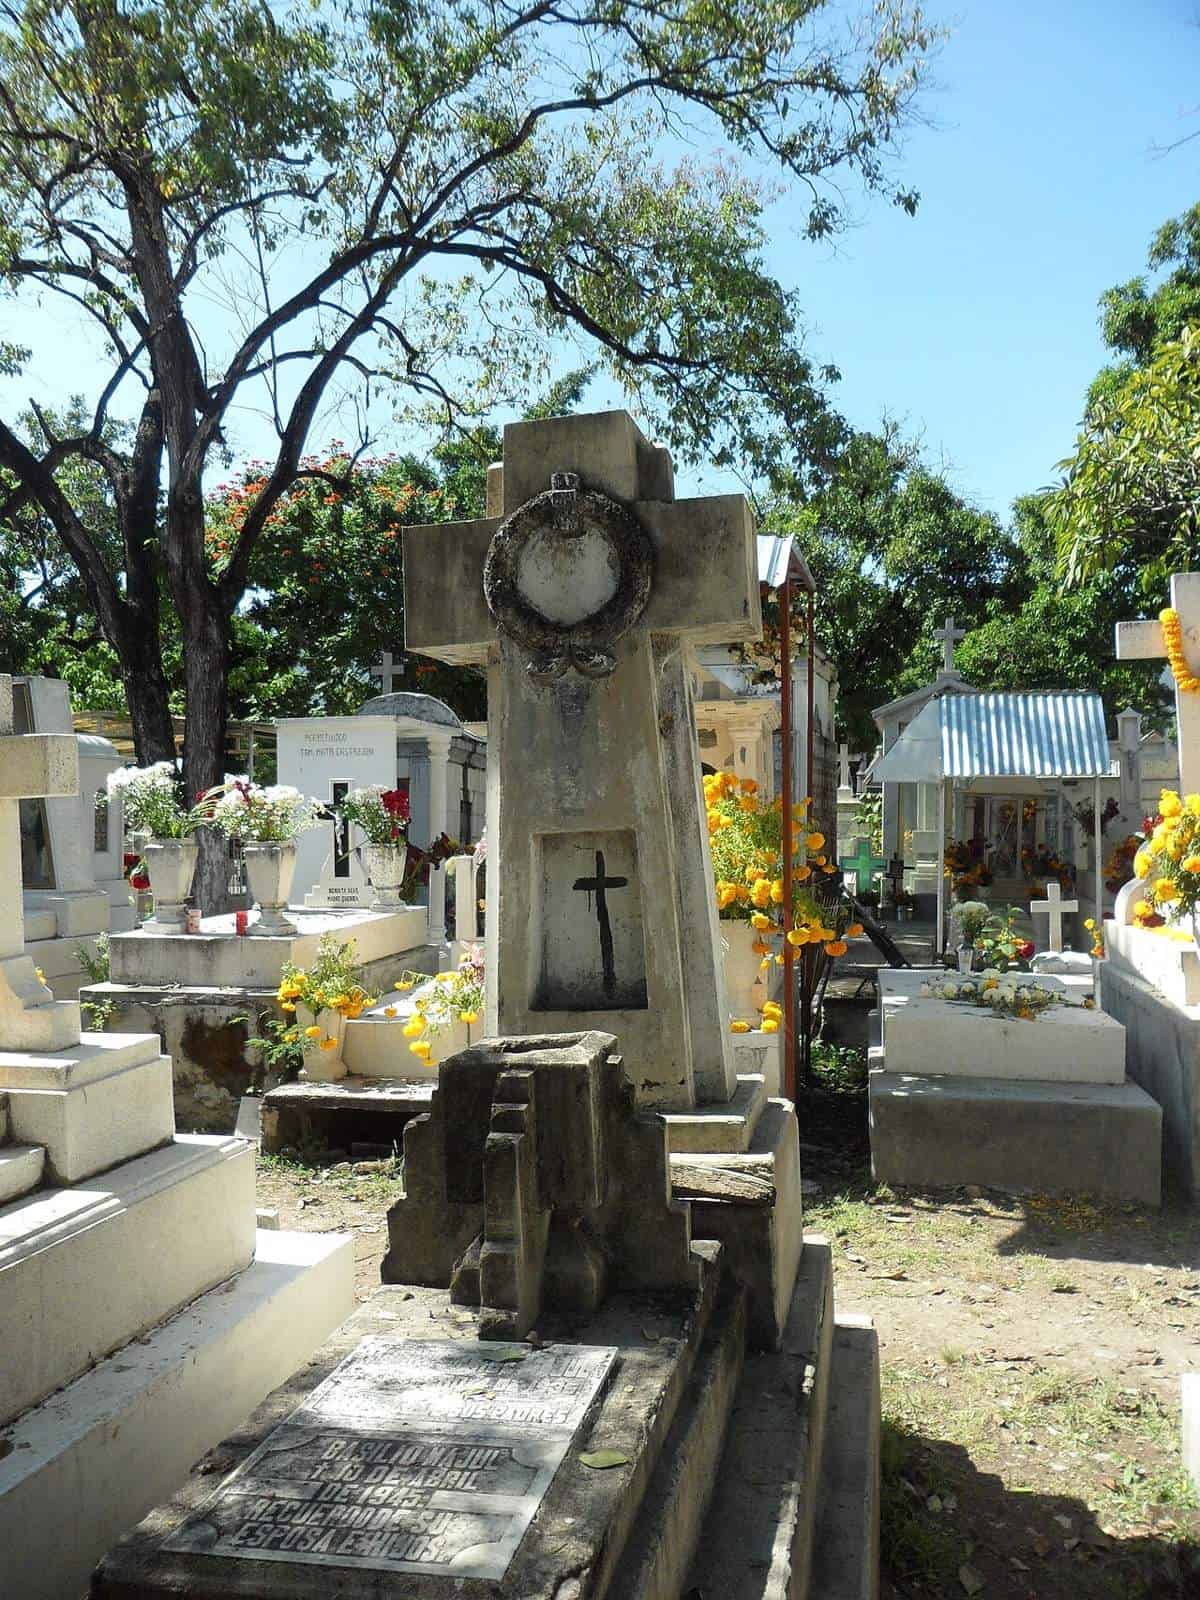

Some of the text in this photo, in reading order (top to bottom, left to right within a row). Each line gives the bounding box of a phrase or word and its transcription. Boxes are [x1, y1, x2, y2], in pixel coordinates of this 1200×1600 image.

[491, 1407, 568, 1423] PADRES
[321, 1440, 423, 1465] BASILIO
[366, 1465, 411, 1485] DE
[409, 1467, 482, 1490] ABRIL
[318, 1482, 357, 1502] DE
[229, 1523, 332, 1552] ESPOSA
